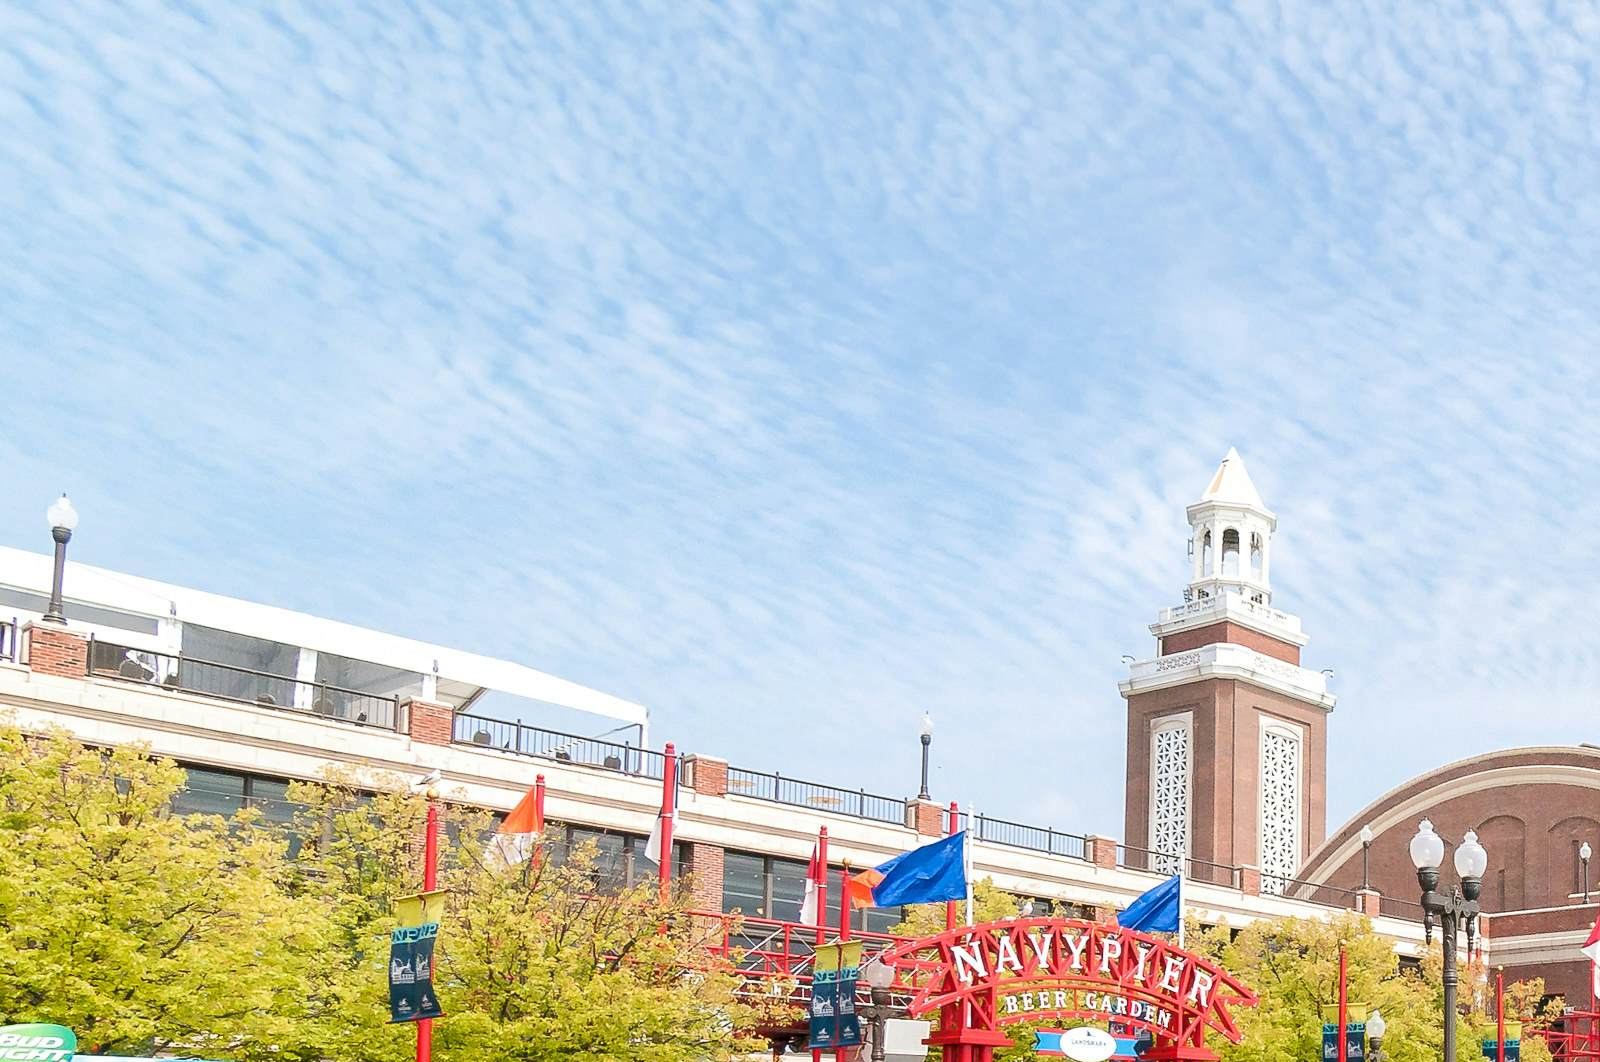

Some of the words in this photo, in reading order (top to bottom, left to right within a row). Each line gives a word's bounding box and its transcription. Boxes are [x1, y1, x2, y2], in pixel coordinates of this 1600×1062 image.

[950, 933, 1090, 982] NAVY
[1100, 938, 1214, 1009] PIER
[1005, 990, 1068, 1014] BEER
[1086, 991, 1172, 1029] GARDEN
[0, 1034, 64, 1048] BUD
[0, 1048, 72, 1062] IGHT
